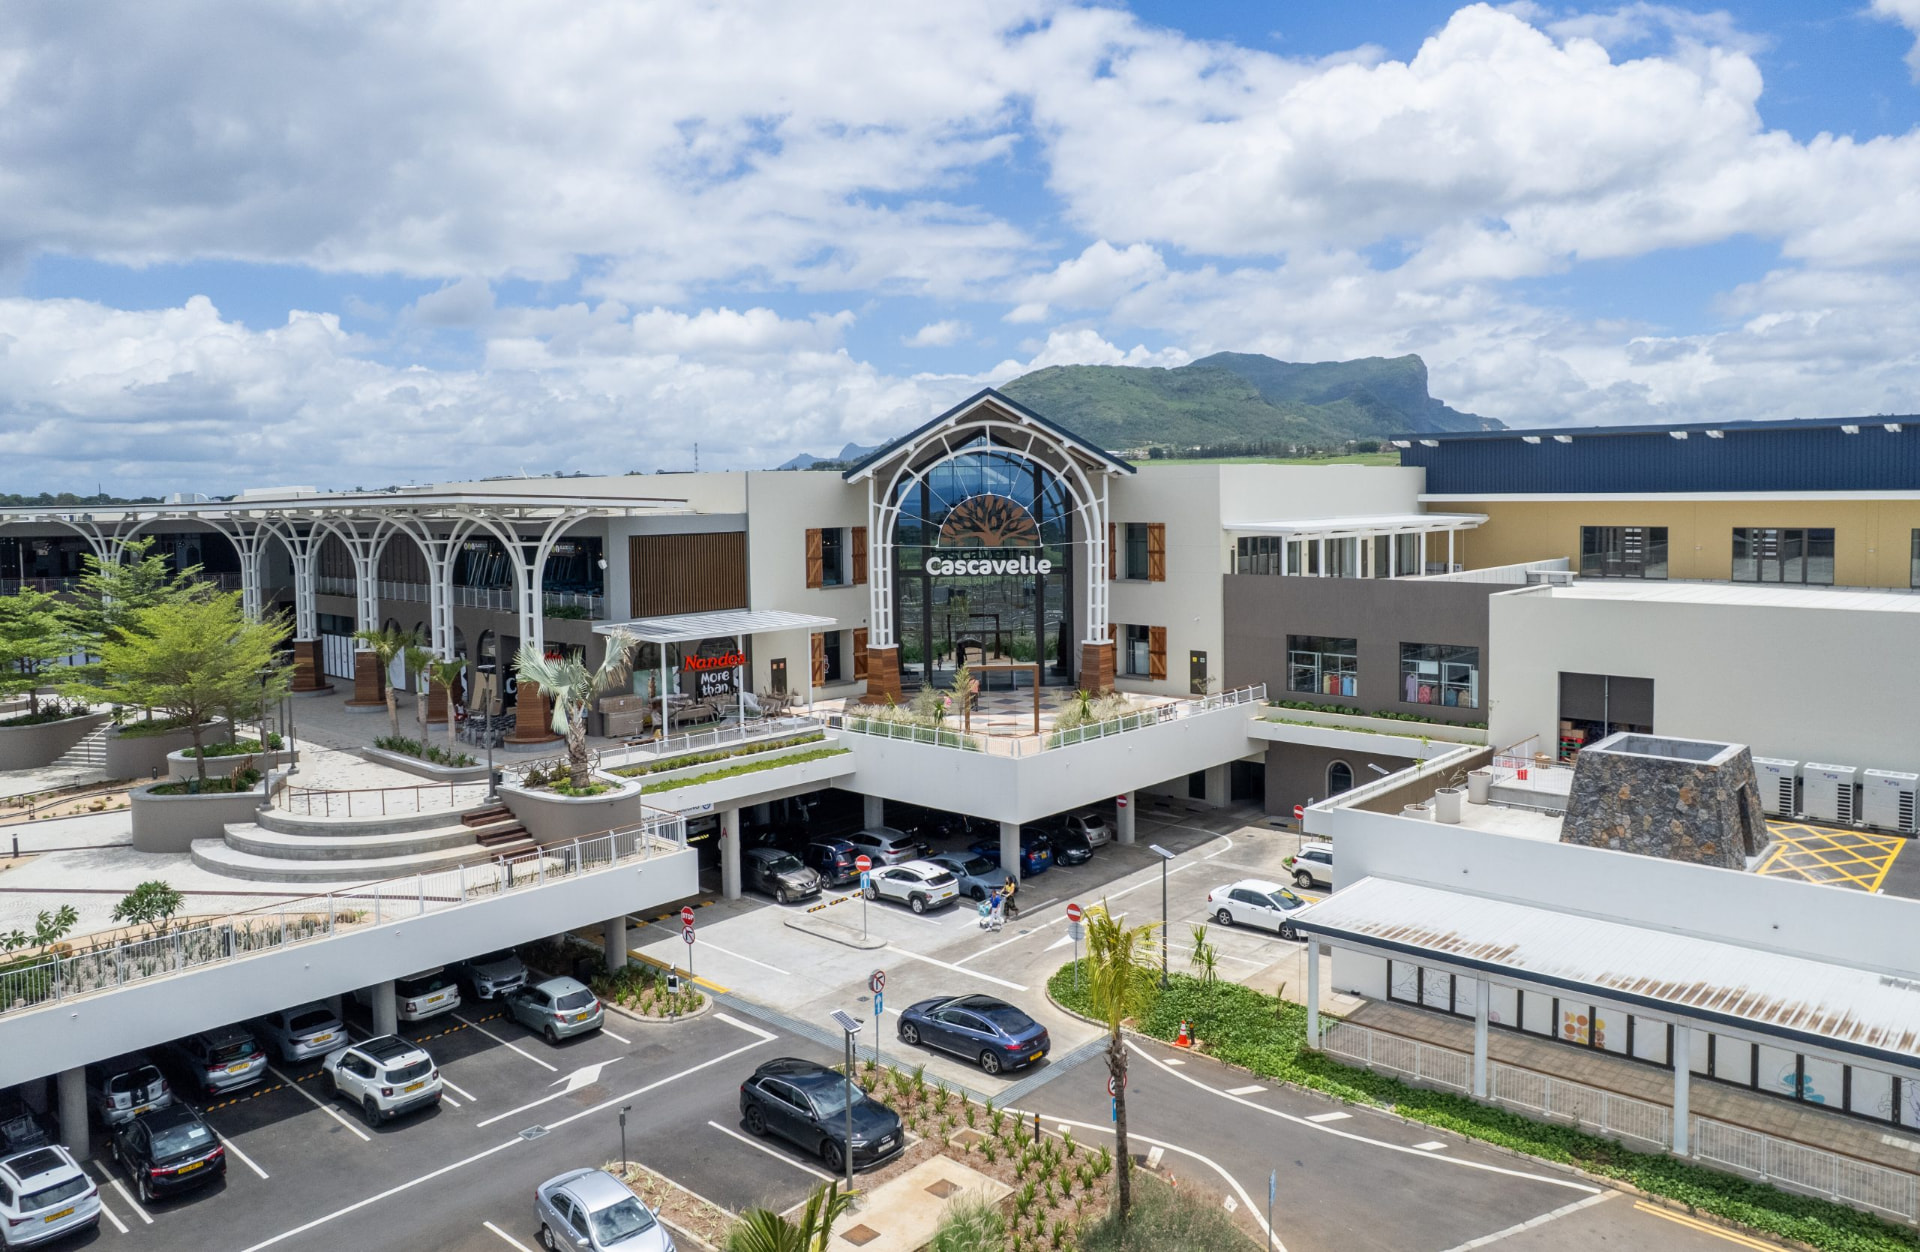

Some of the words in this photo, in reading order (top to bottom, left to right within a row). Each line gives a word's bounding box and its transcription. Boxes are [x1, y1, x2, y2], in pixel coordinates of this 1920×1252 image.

[926, 556, 1051, 575] Cascavelle
[685, 649, 745, 671] Nando's
[701, 671, 730, 685] More
[702, 683, 728, 696] than
[722, 828, 728, 838] A
[682, 912, 694, 920] STOP
